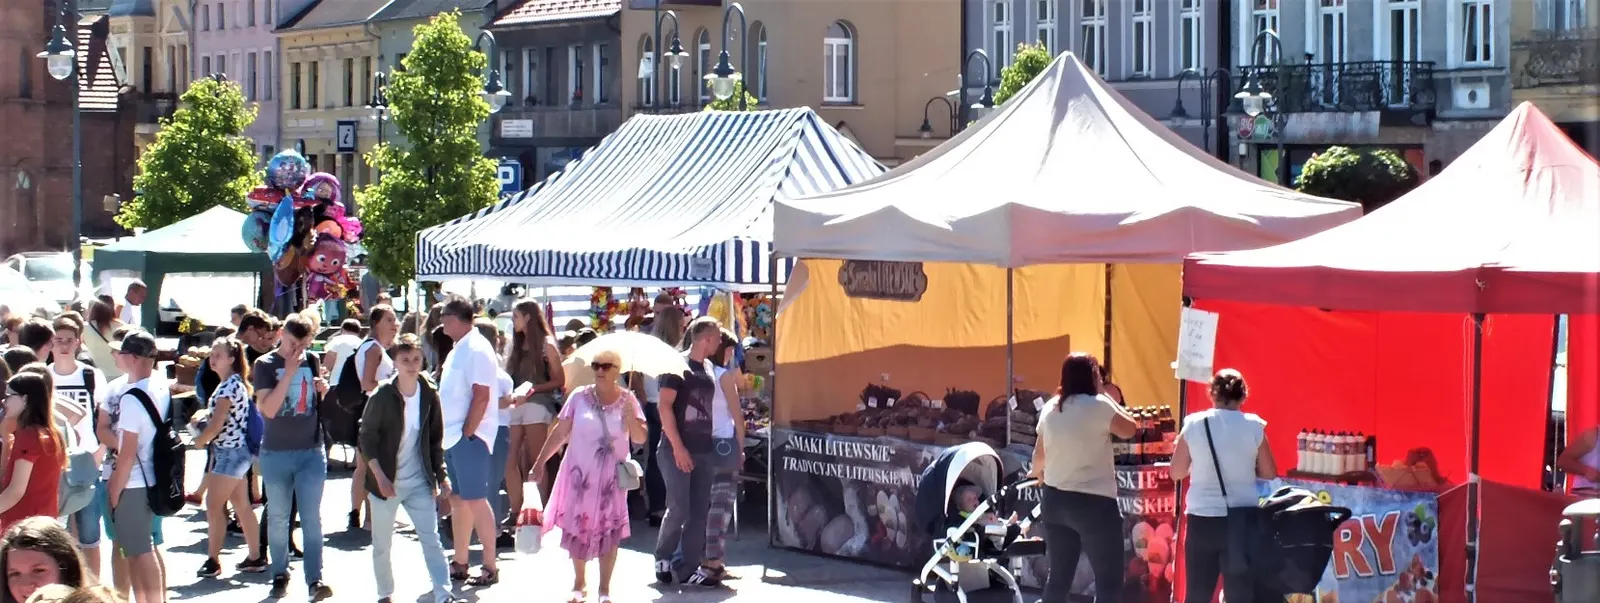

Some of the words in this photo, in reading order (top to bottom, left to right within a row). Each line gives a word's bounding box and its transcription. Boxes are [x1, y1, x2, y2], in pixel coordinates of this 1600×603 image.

[498, 166, 514, 192] P
[782, 456, 844, 478] TRADYCYJNE
[846, 464, 900, 486] LITEWSKIE
[1116, 470, 1169, 490] SKIE“
[1332, 510, 1400, 579] RY
